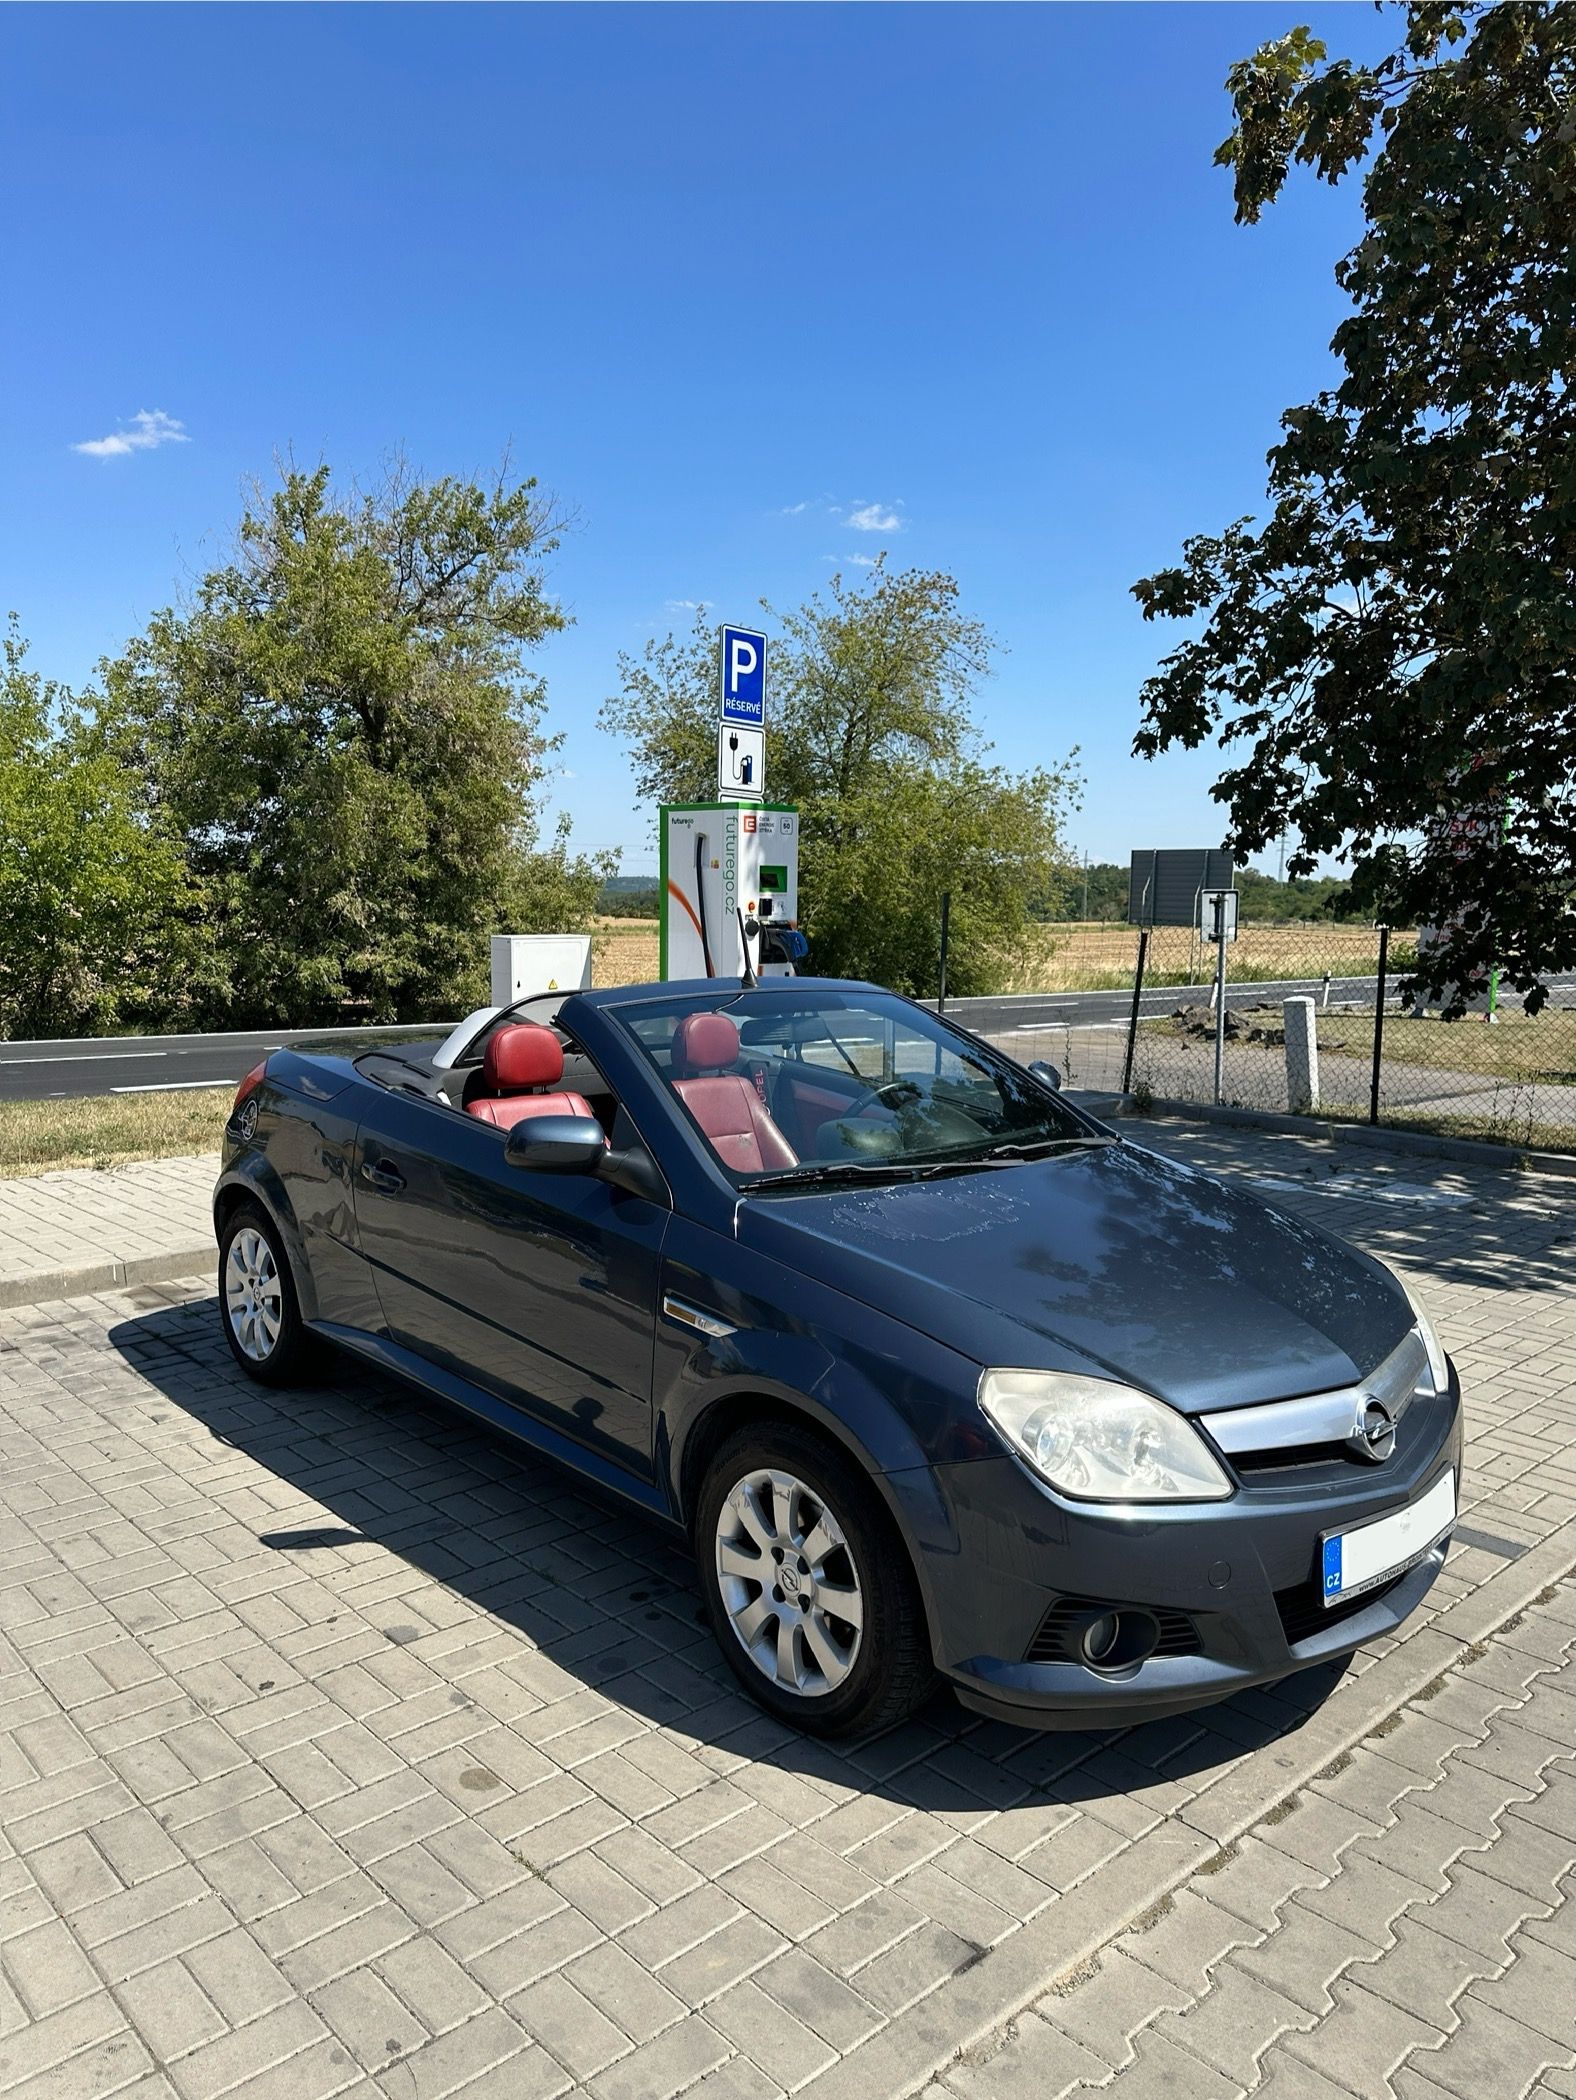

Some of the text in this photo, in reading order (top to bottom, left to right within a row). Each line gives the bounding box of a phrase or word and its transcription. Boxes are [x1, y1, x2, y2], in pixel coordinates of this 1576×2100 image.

[732, 640, 757, 692] P
[725, 697, 761, 715] RÉSERVÉ
[723, 815, 738, 915] futurego.cz
[1327, 1573, 1340, 1588] CZ
